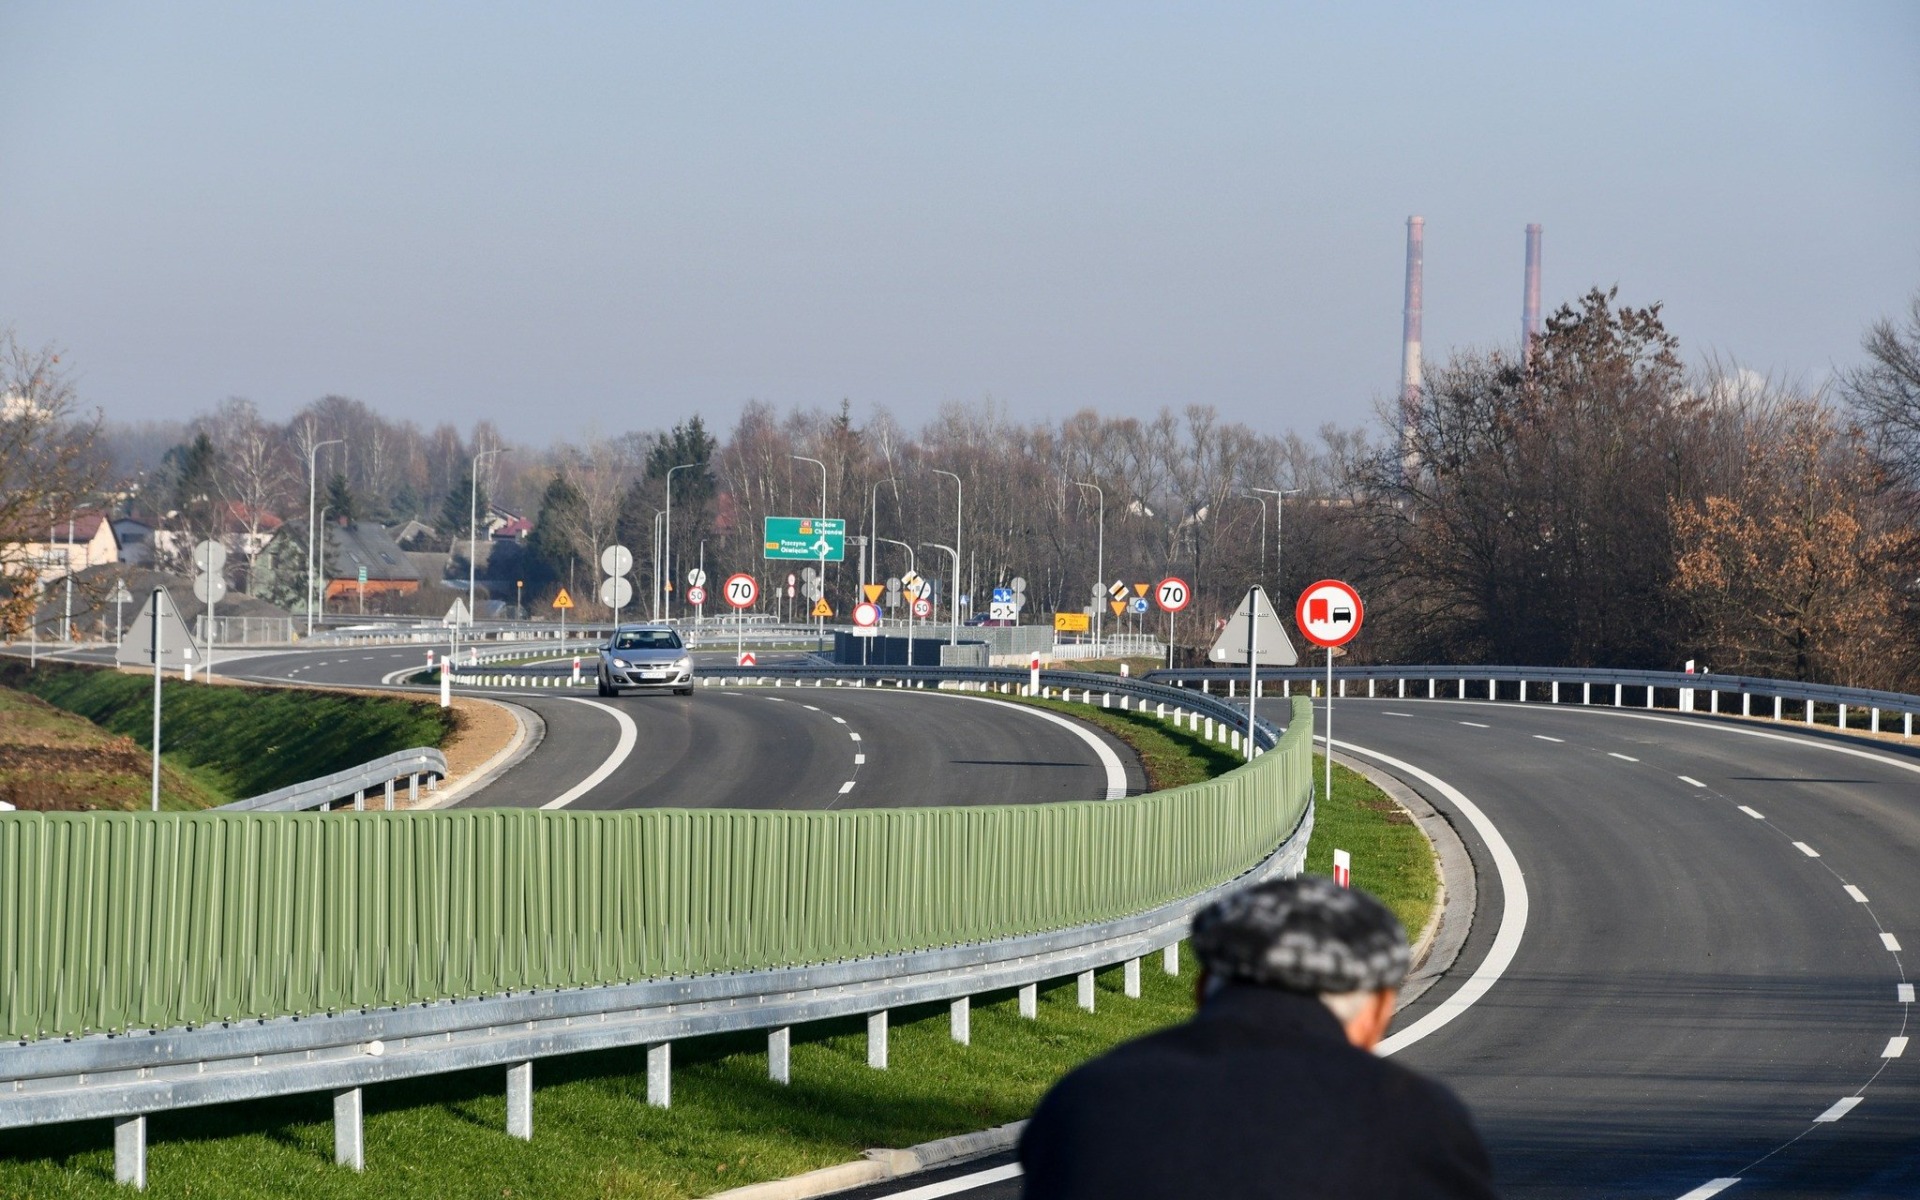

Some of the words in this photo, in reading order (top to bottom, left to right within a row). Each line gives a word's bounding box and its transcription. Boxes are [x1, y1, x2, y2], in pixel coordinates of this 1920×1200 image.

[781, 539, 806, 548] Pszczyna
[691, 591, 703, 600] 50
[730, 583, 751, 599] 70
[1162, 587, 1183, 602] 70
[916, 604, 928, 612] 50
